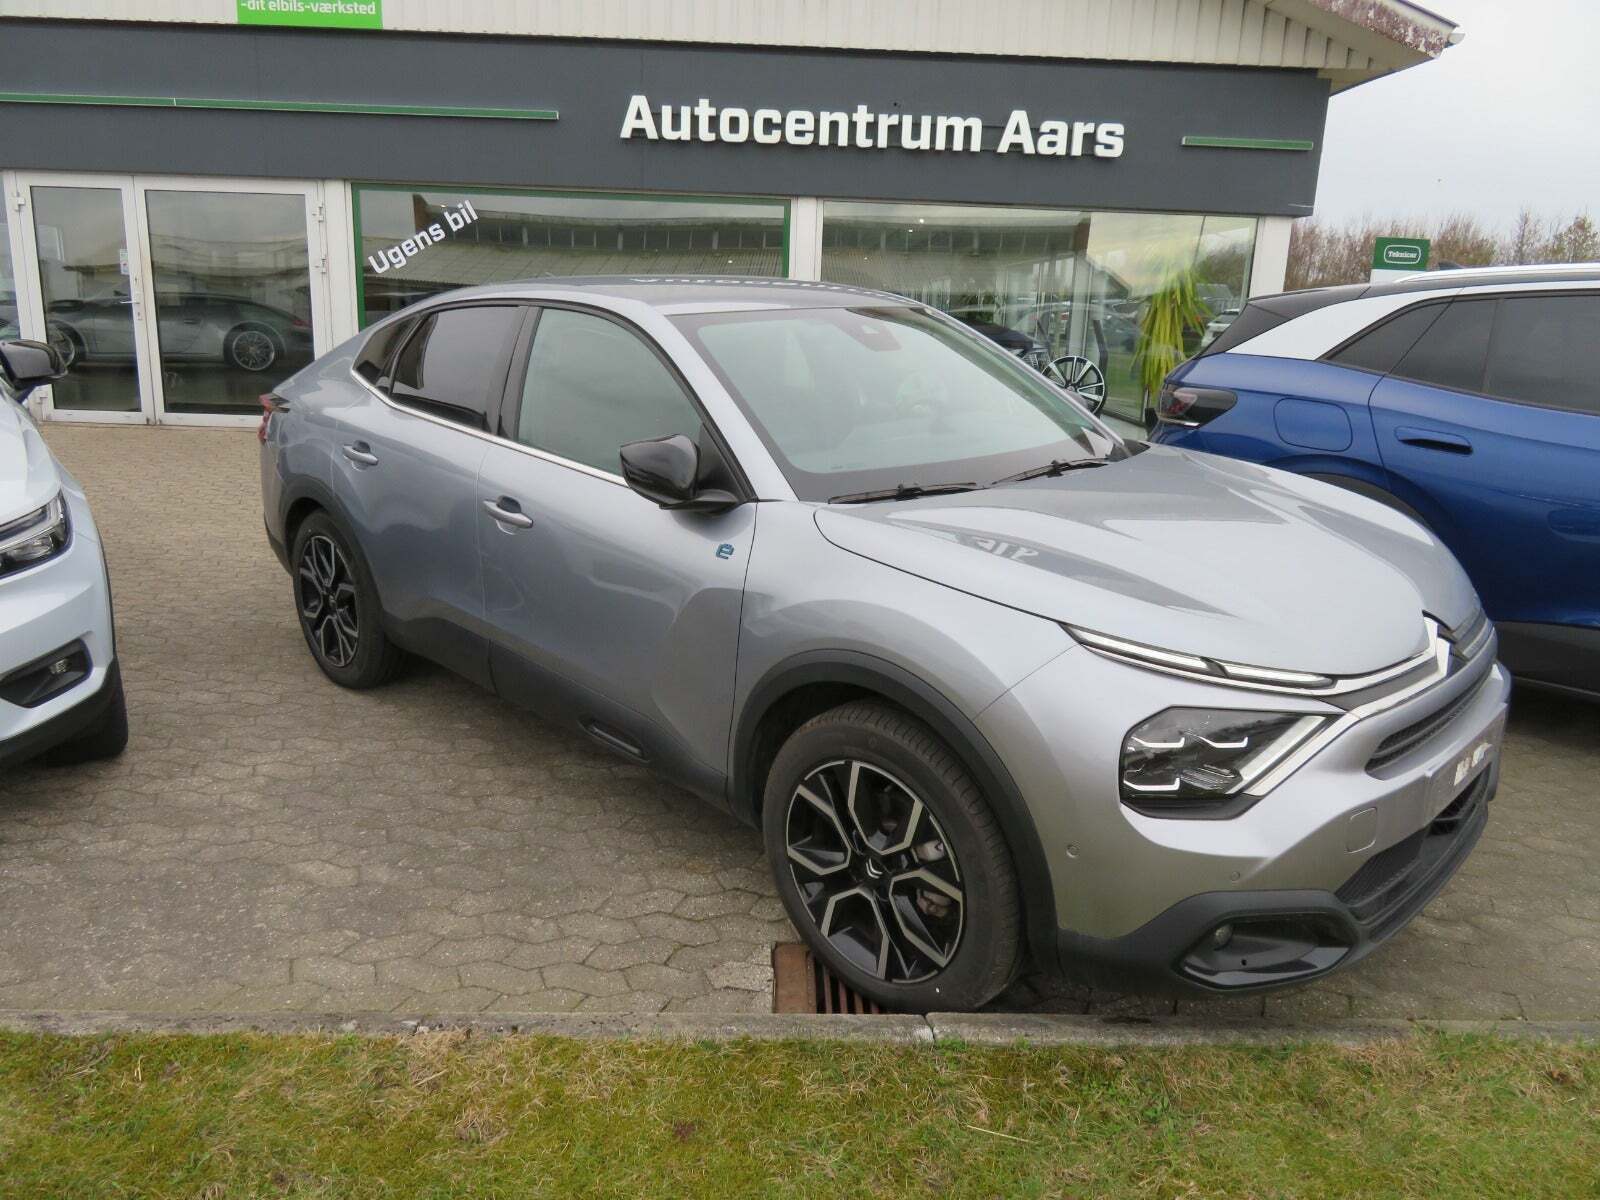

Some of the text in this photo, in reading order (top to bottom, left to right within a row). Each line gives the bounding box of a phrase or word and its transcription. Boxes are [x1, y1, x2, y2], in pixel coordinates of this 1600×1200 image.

[240, 0, 377, 15] -dit elbils-værksted
[619, 94, 1126, 159] Autocentrum Aars
[367, 199, 479, 274] Ugens bil
